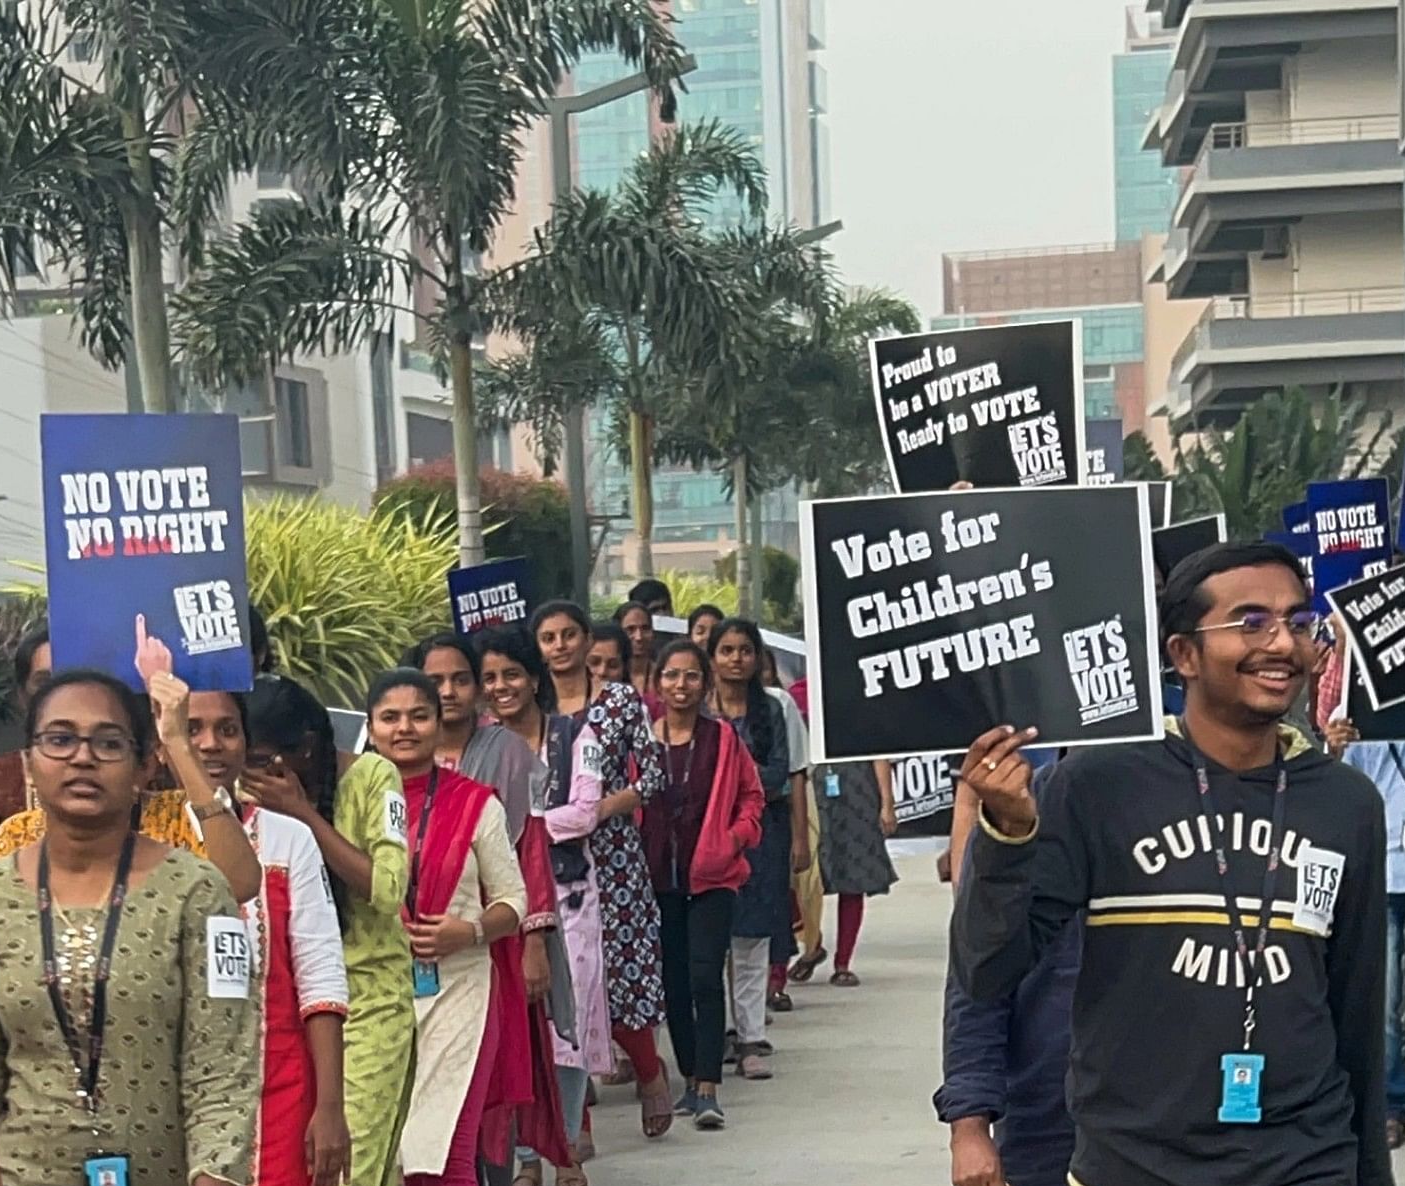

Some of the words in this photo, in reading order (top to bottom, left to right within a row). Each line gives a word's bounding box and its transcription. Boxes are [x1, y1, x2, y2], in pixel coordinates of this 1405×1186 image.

[881, 348, 933, 389] Proud
[936, 345, 957, 367] to
[889, 398, 909, 422] be
[911, 394, 924, 413] a
[924, 362, 1001, 407] VOTER
[897, 417, 944, 454] Ready
[947, 410, 968, 436] to
[971, 385, 1041, 428] VOTE
[1013, 444, 1065, 477] VOTE
[60, 472, 112, 515] NO
[115, 466, 209, 509] VOTE
[65, 517, 115, 561] NO
[121, 510, 228, 557] RIGHT
[1315, 510, 1336, 532] NO
[1337, 504, 1377, 529] VOTE
[1318, 532, 1338, 555] NO
[1340, 525, 1385, 554] RIGHT
[832, 530, 932, 579] Vote
[941, 508, 1000, 556] for
[457, 592, 478, 613] NO
[479, 582, 517, 607] VOTE
[461, 611, 483, 633] NO
[483, 599, 526, 625] RIGHT
[846, 552, 1054, 641] Children's
[1345, 592, 1384, 622] Vote
[180, 608, 240, 643] VOTE
[857, 613, 1041, 698] FUTURE
[1071, 659, 1135, 707] VOTE
[891, 754, 953, 803] VOTE
[1304, 885, 1333, 912] VOTE
[215, 955, 247, 976] VOTE
[1171, 937, 1292, 988] MIND
